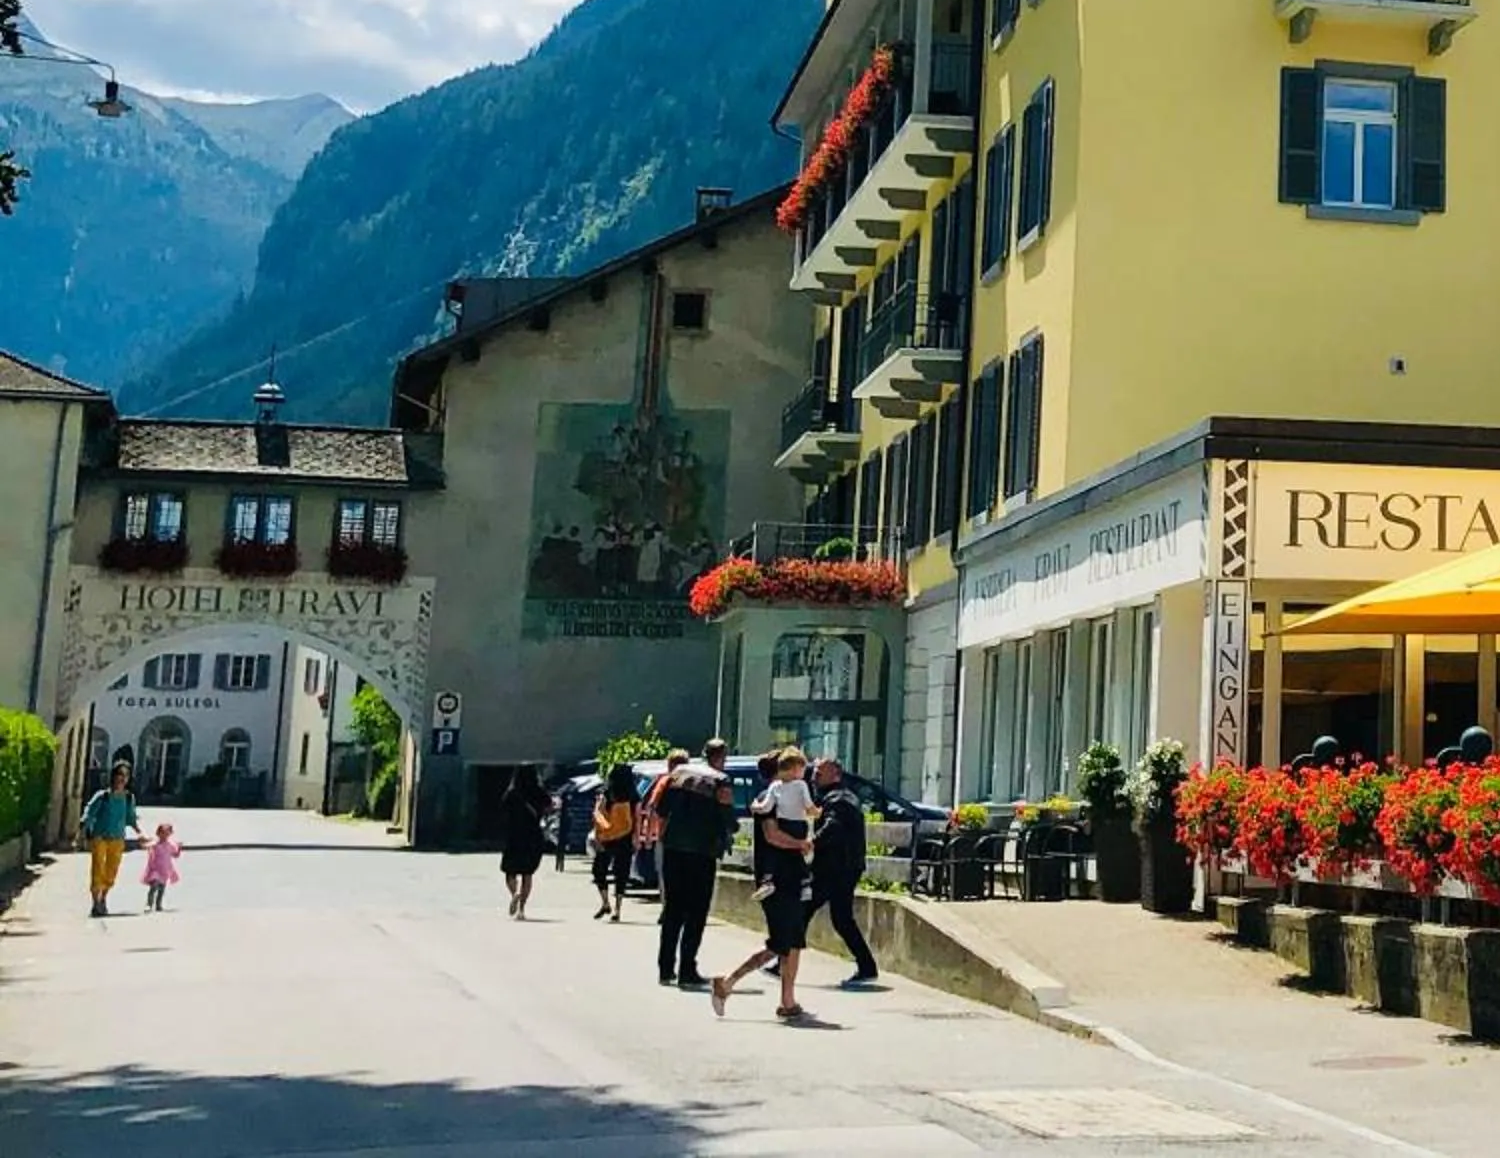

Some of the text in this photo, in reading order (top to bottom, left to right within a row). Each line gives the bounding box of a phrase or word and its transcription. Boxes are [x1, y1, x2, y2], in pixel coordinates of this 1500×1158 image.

[120, 585, 385, 617] HOTEL FRAVI
[437, 731, 453, 753] P
